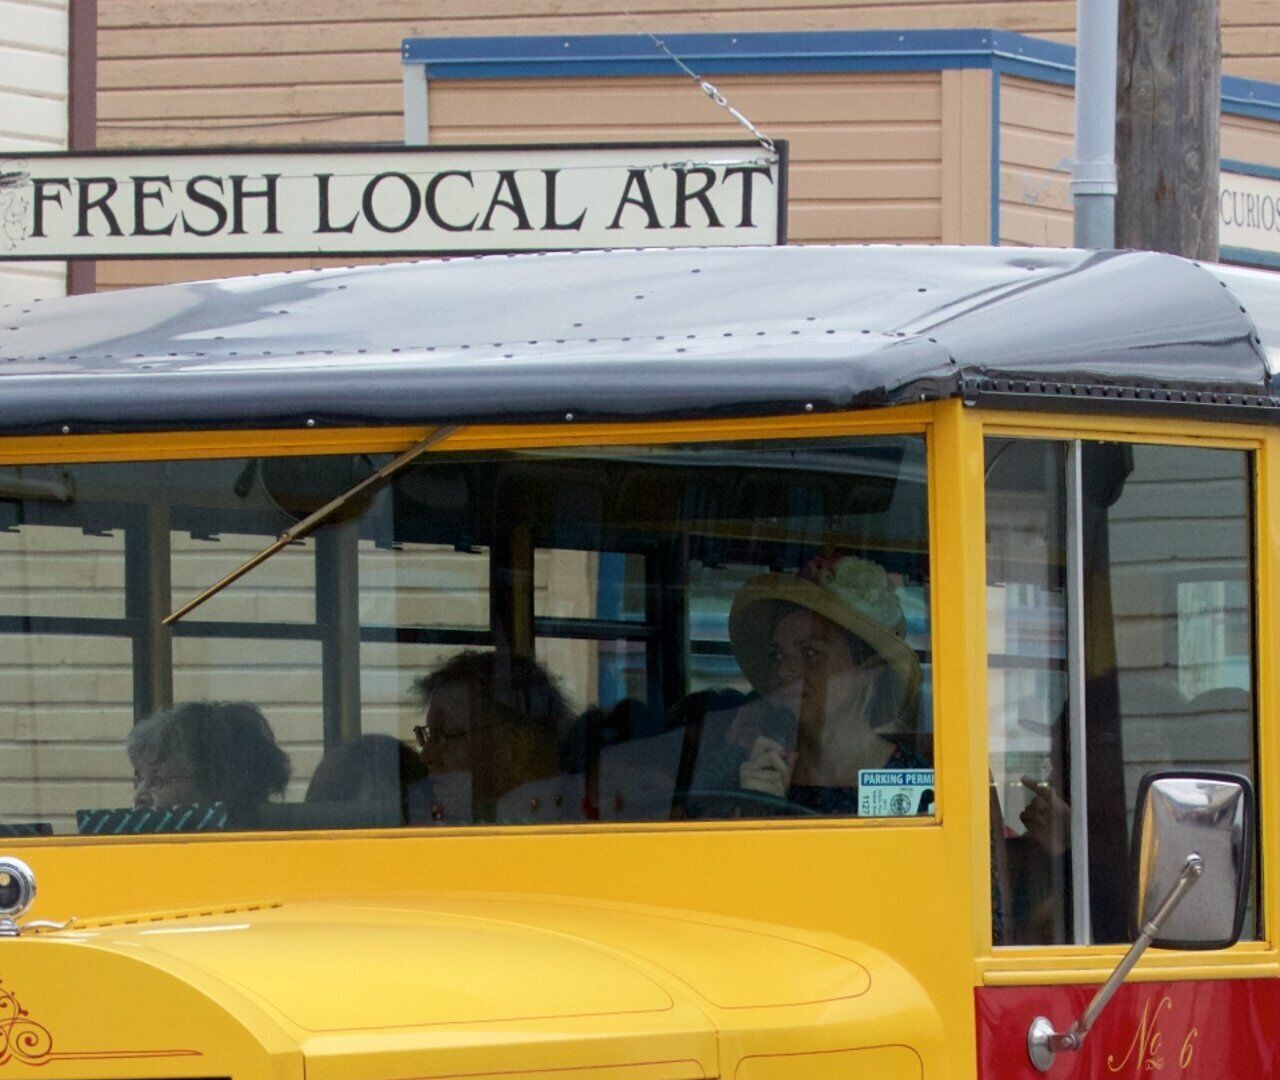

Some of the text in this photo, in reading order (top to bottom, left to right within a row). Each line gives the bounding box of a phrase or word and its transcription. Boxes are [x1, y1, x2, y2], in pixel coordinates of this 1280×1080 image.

[29, 165, 774, 238] FRESH LOCAL ART
[863, 773, 903, 785] PARKING
[1180, 1027, 1198, 1069] 6
